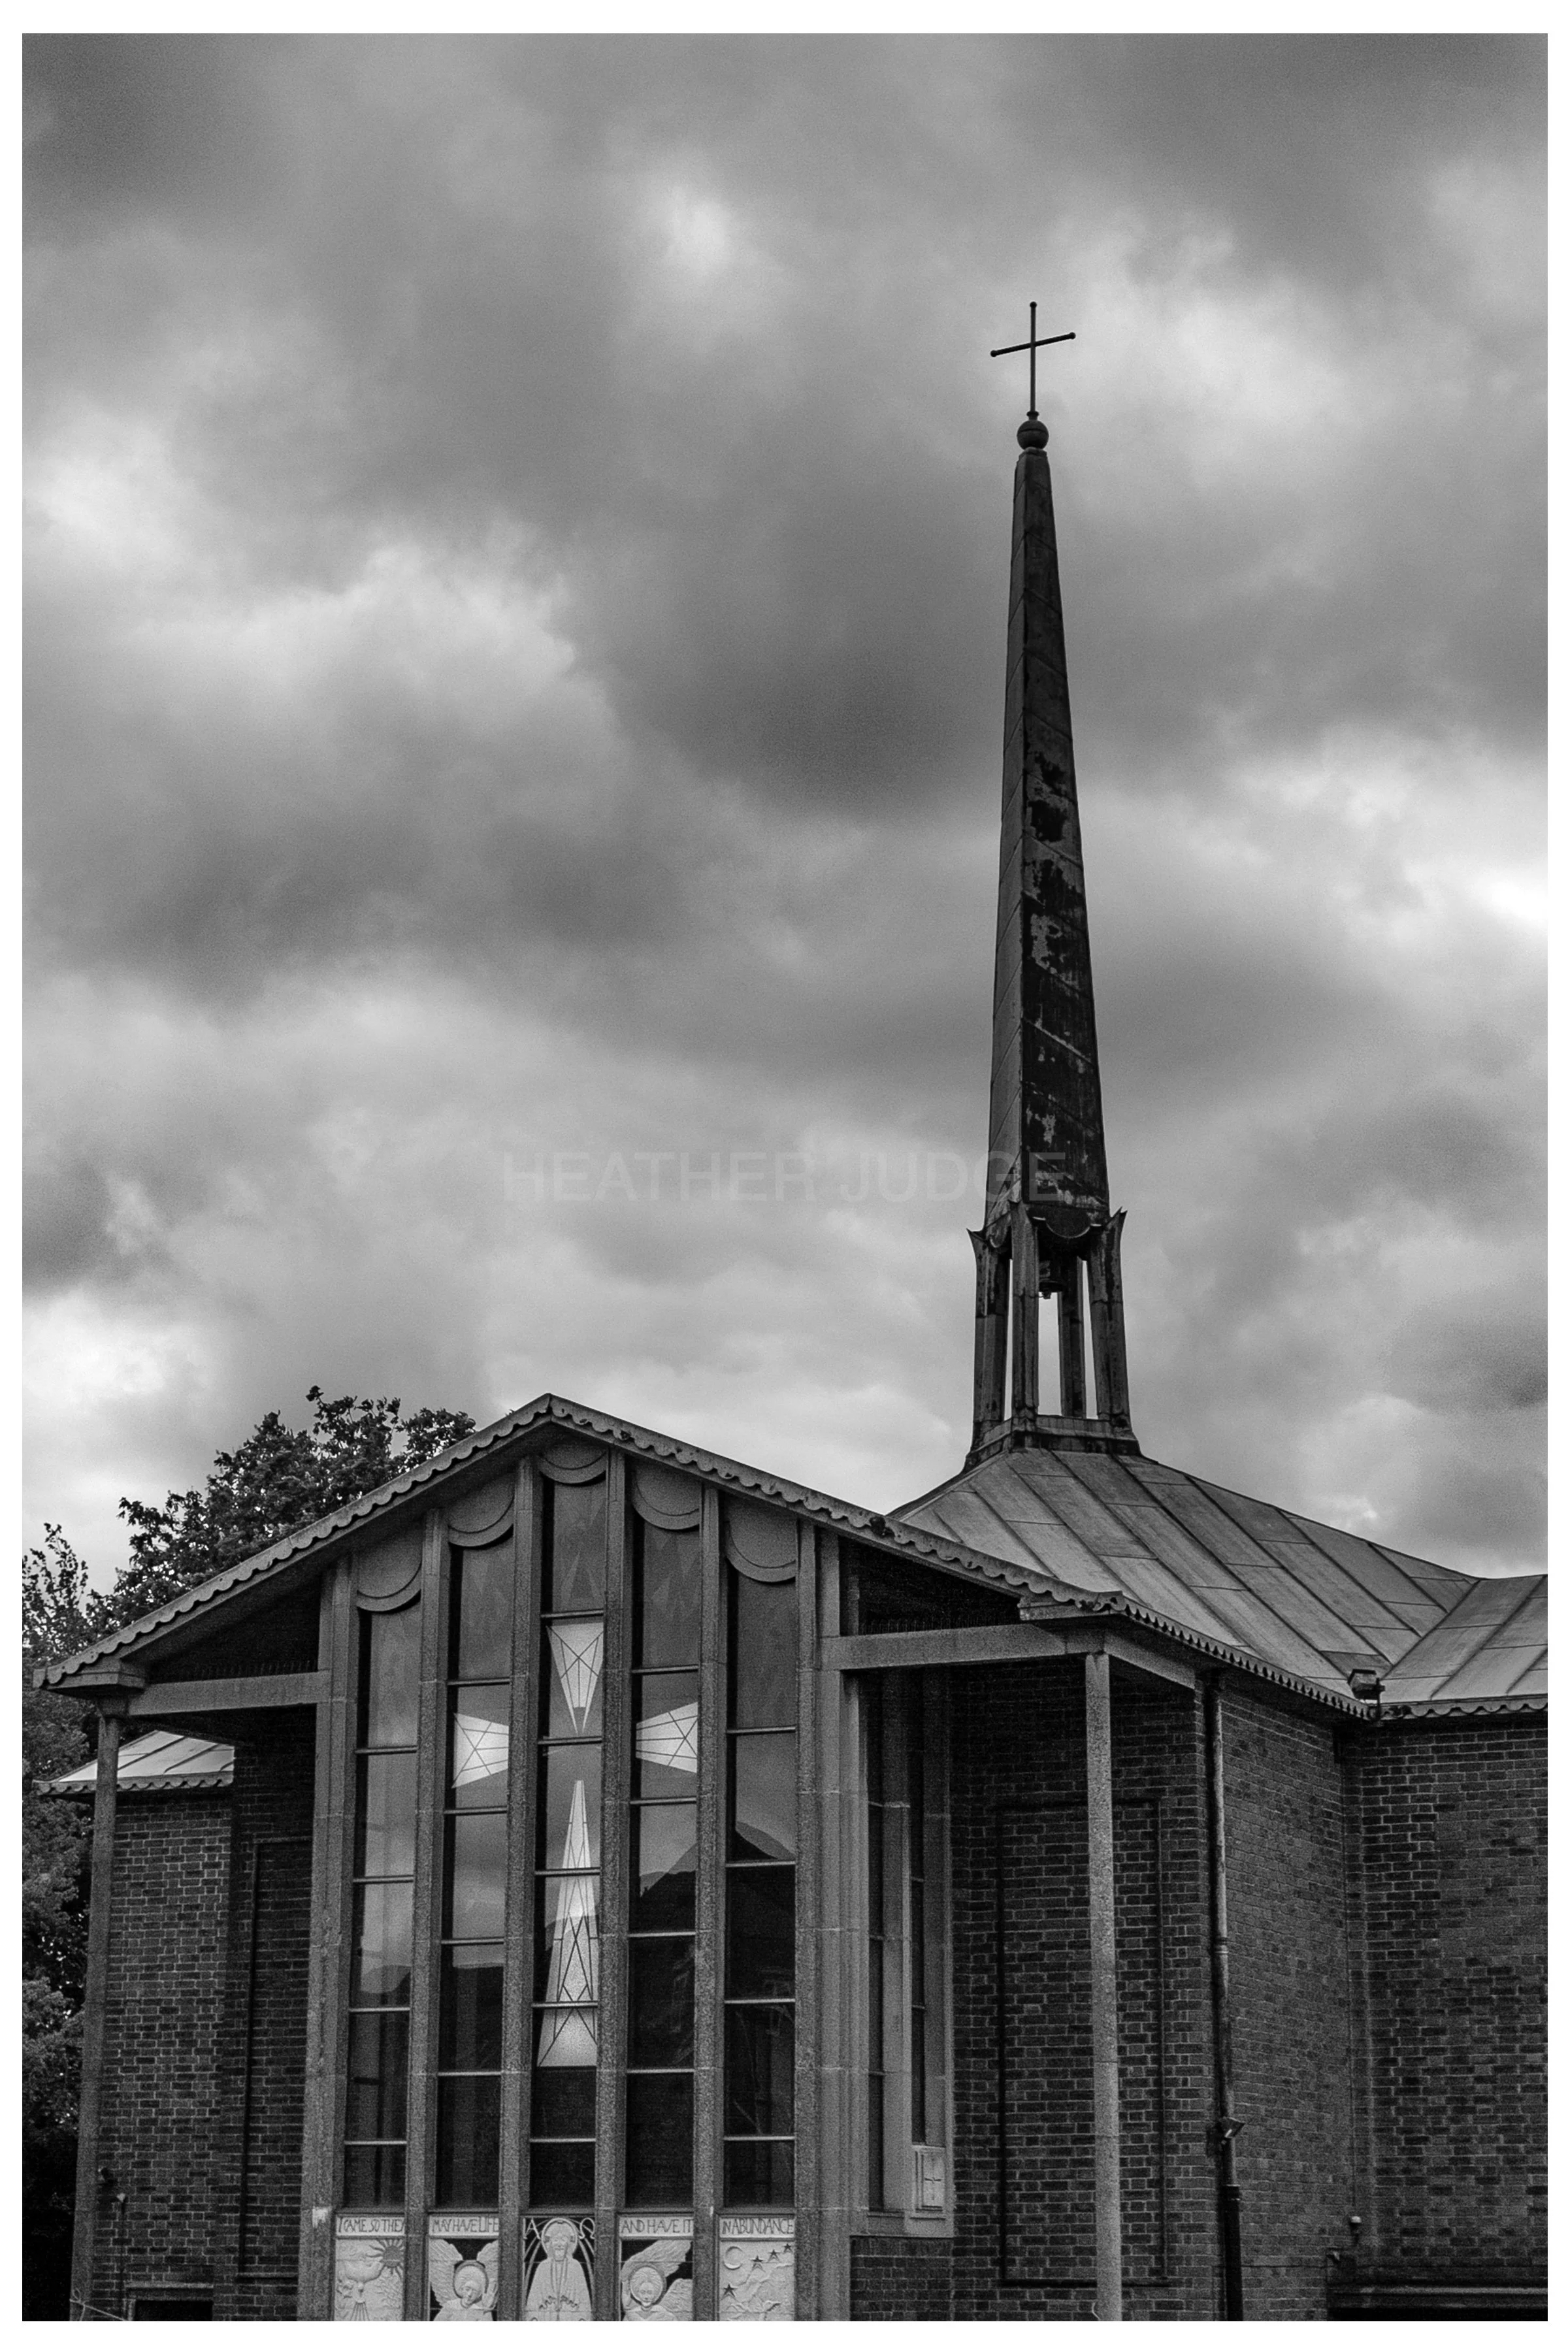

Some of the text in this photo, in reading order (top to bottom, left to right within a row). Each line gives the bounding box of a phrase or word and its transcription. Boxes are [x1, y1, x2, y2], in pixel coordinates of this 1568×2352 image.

[344, 2219, 367, 2232] CAME
[368, 2219, 380, 2232] SO
[432, 2217, 499, 2232] MAY HAVE LIFE
[621, 2218, 694, 2234] AND HAVE IT
[732, 2217, 794, 2234] ABUNDANCE
